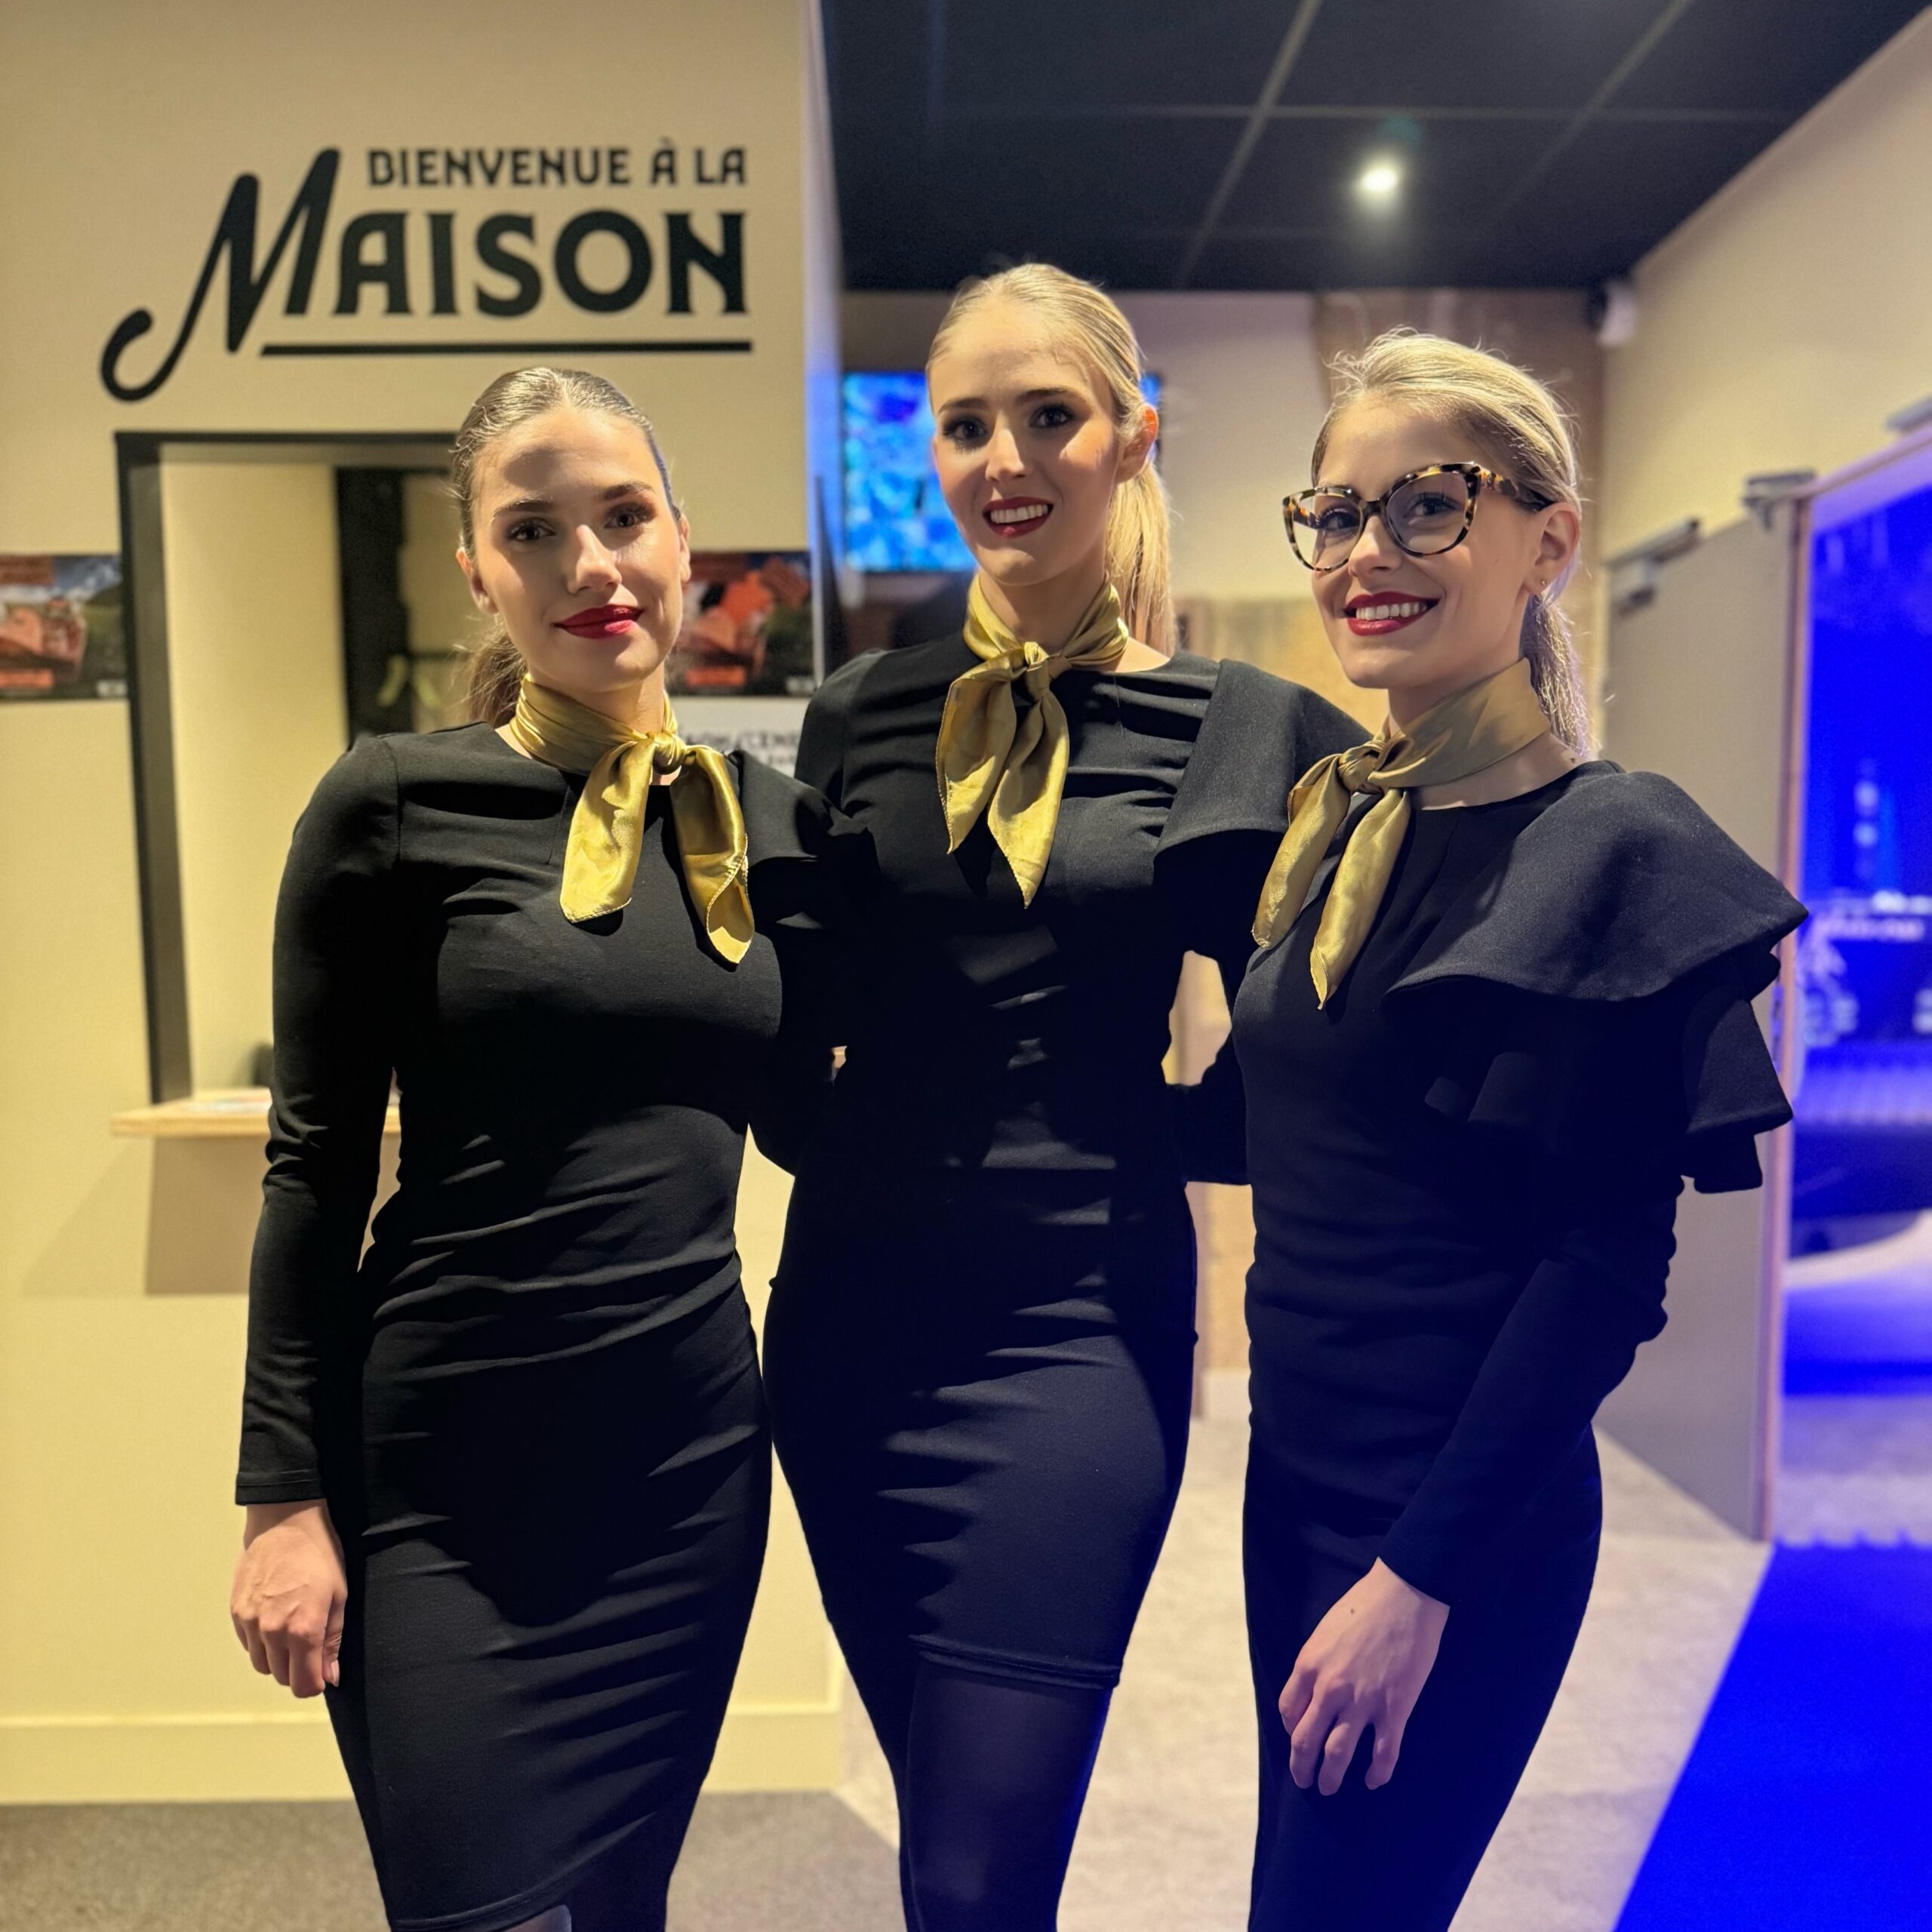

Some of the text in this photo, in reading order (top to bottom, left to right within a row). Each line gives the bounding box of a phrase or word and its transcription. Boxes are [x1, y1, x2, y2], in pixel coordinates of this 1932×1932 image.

[368, 137, 747, 187] BIENVENUE À LA
[100, 146, 749, 403] MAISON
